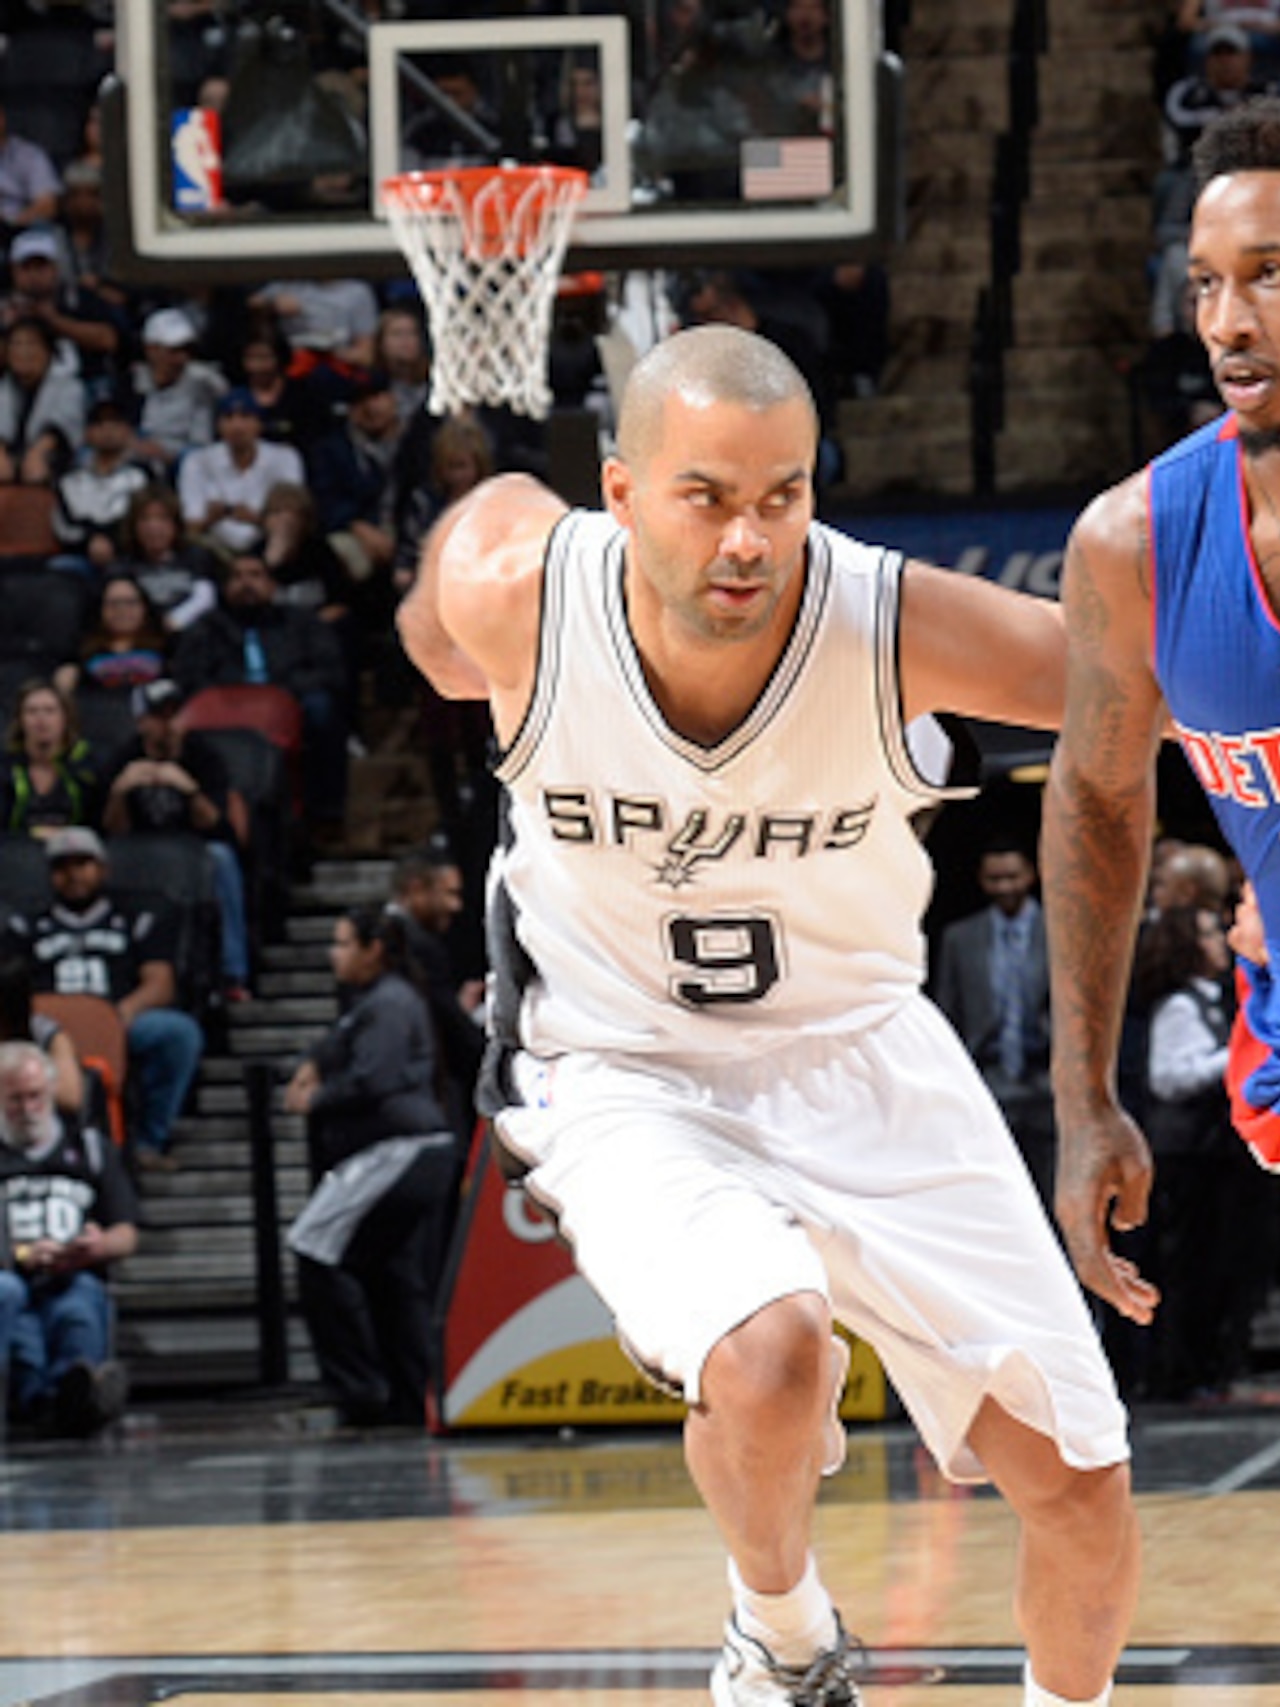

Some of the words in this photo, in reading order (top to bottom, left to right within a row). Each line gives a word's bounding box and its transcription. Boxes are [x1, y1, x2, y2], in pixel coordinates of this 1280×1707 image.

[542, 785, 880, 889] SPURS
[661, 911, 788, 1008] 9
[501, 1379, 570, 1407] Fast
